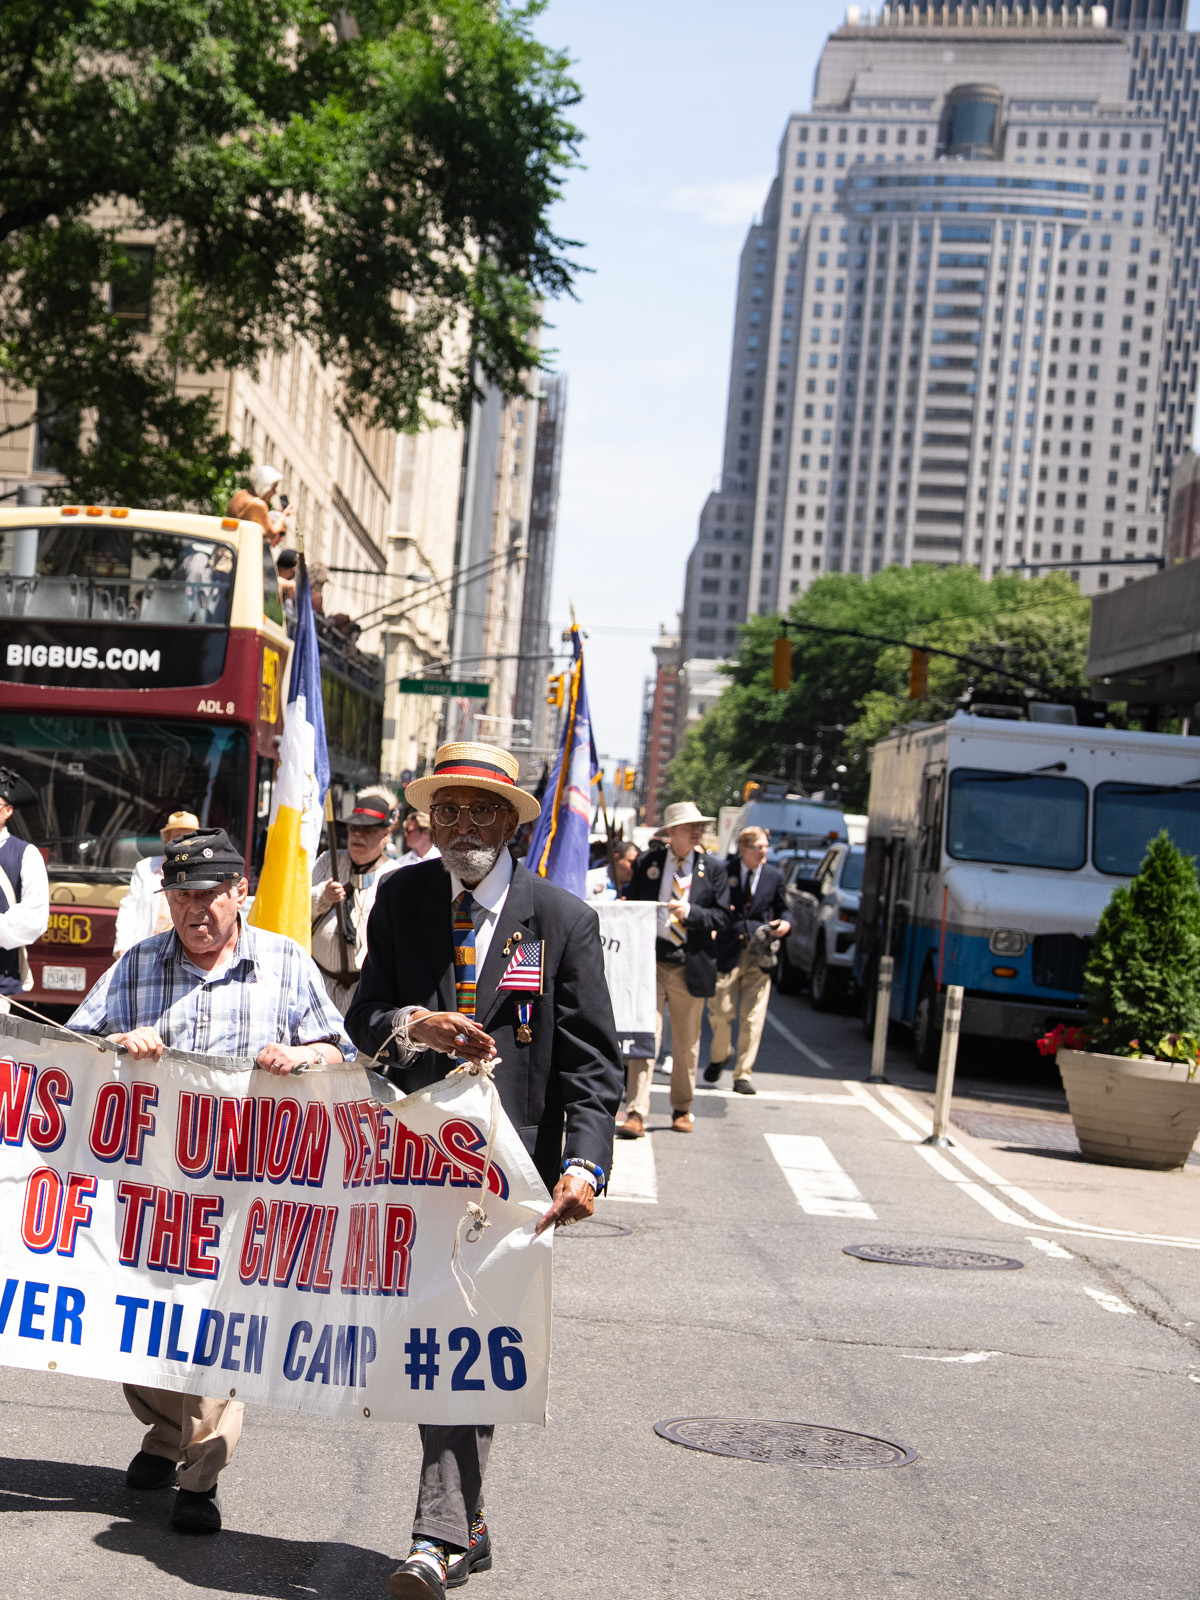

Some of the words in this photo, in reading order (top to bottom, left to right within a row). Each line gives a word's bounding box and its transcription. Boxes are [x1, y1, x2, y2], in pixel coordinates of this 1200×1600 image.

[6, 643, 161, 672] BIGBUS.COM
[197, 699, 224, 714] ADL
[226, 701, 235, 715] 8
[89, 1081, 159, 1165] OF
[175, 1090, 332, 1188] UNION
[333, 1097, 510, 1201] VETERAS
[21, 1166, 98, 1259] OF
[117, 1180, 224, 1280] THE
[238, 1197, 339, 1295] CIVIL
[341, 1202, 417, 1297] WAR
[115, 1294, 269, 1375] TILDEN
[282, 1320, 378, 1389] CAMP
[404, 1326, 528, 1392] #26
